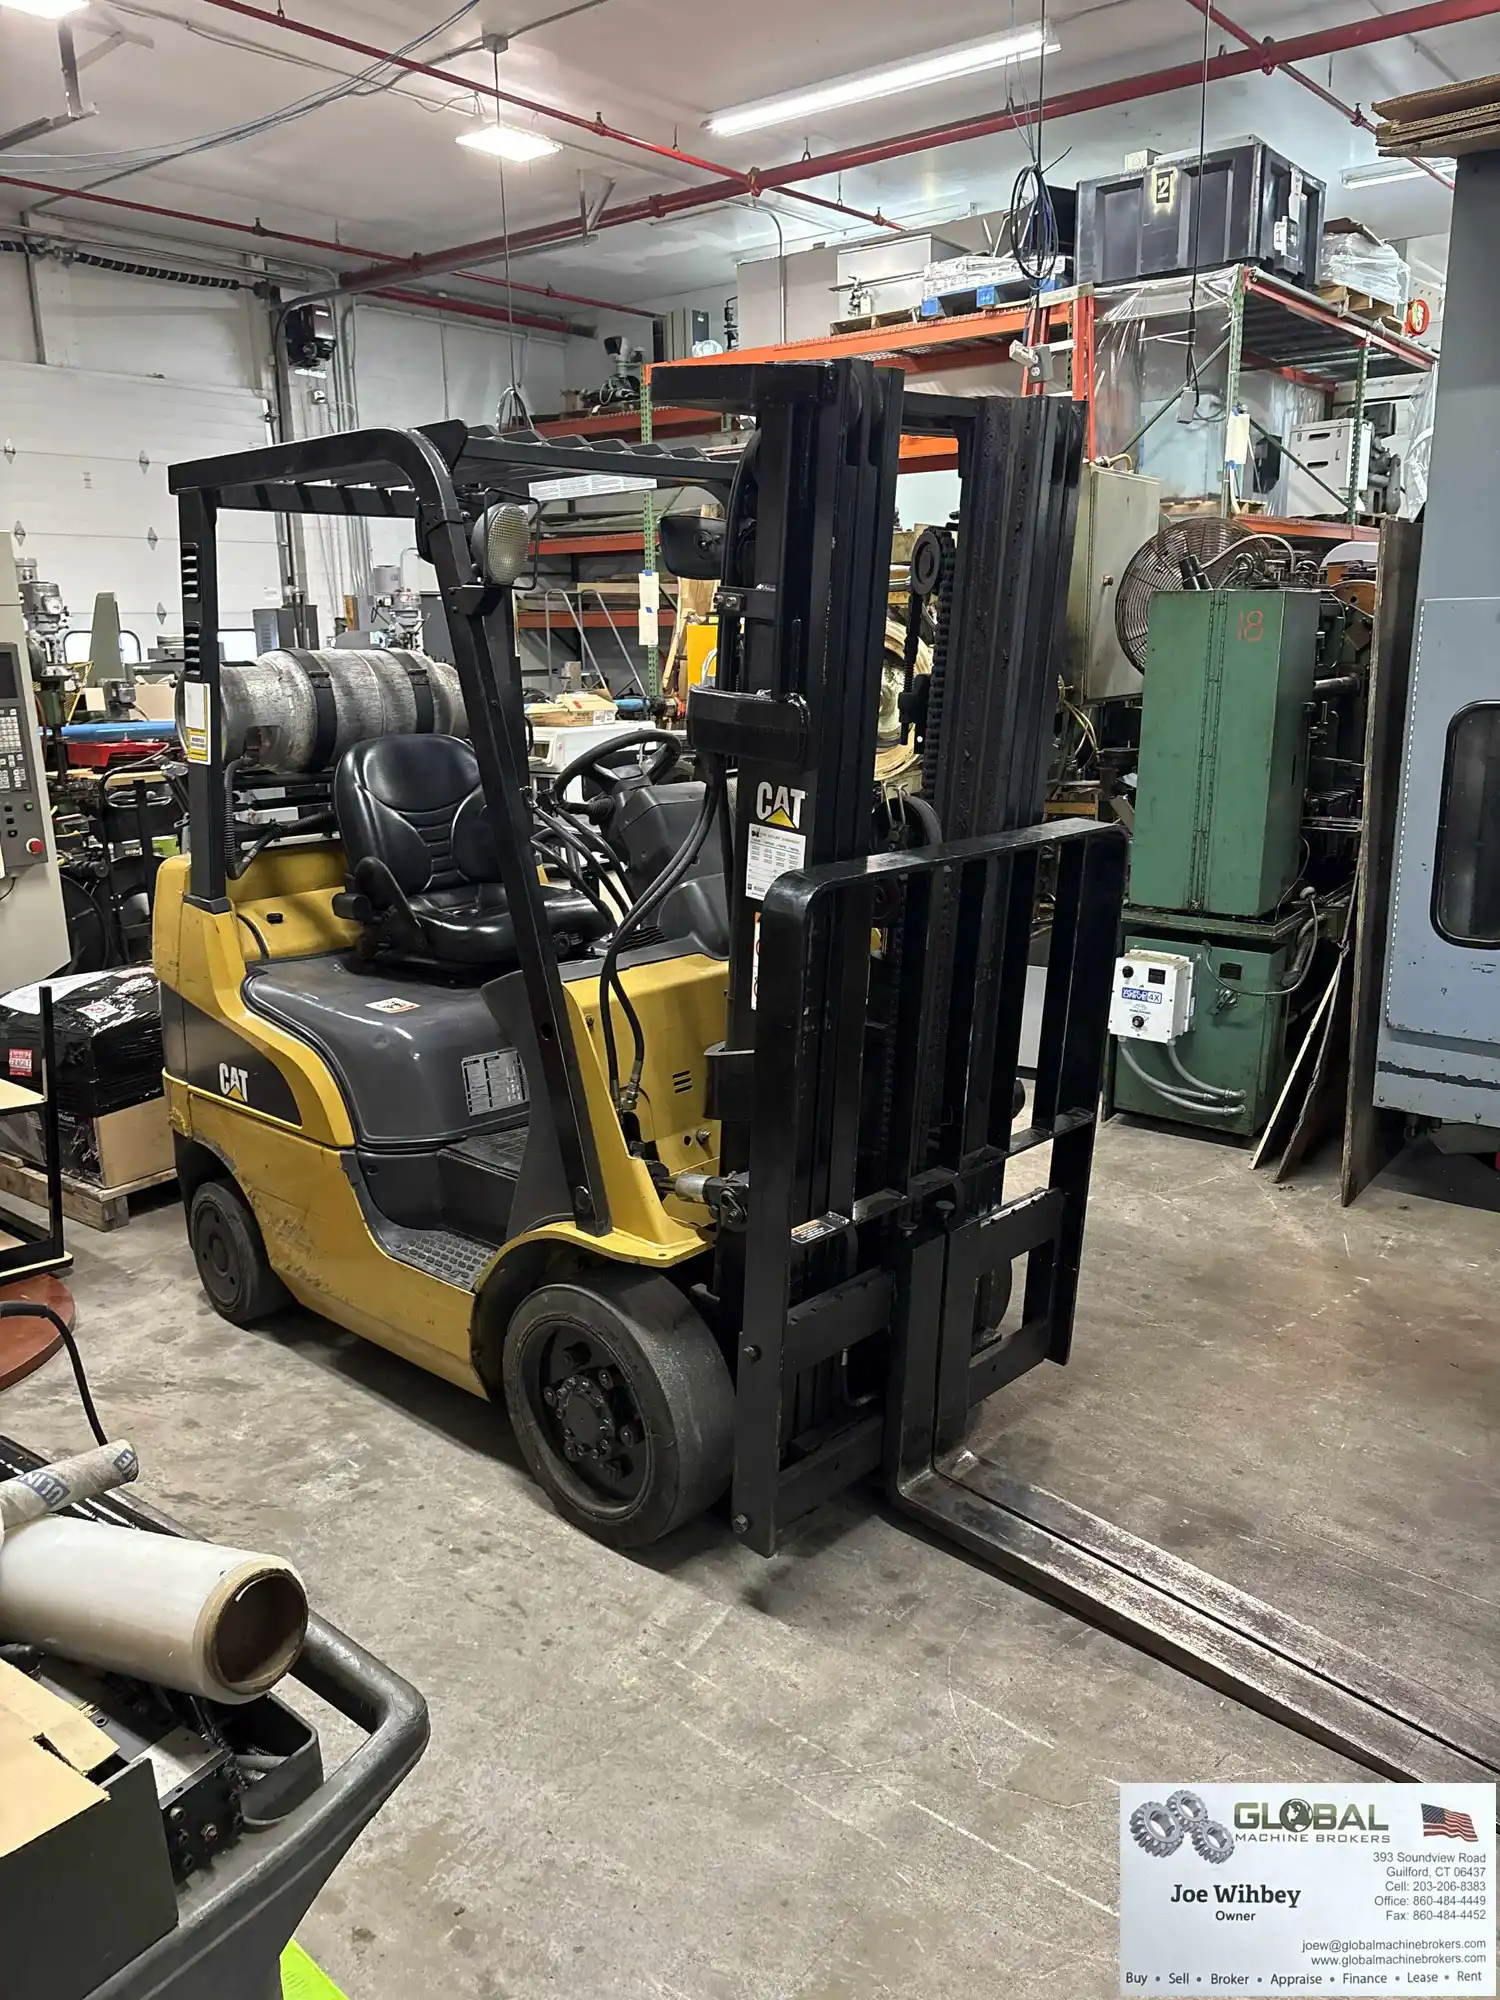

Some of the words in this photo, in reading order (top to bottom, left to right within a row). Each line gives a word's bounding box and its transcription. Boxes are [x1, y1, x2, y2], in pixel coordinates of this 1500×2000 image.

[1157, 177, 1170, 199] 2
[1237, 609, 1264, 642] 18
[756, 781, 806, 829] CAT
[1149, 994, 1160, 1002] 4X
[218, 1062, 249, 1102] CAT
